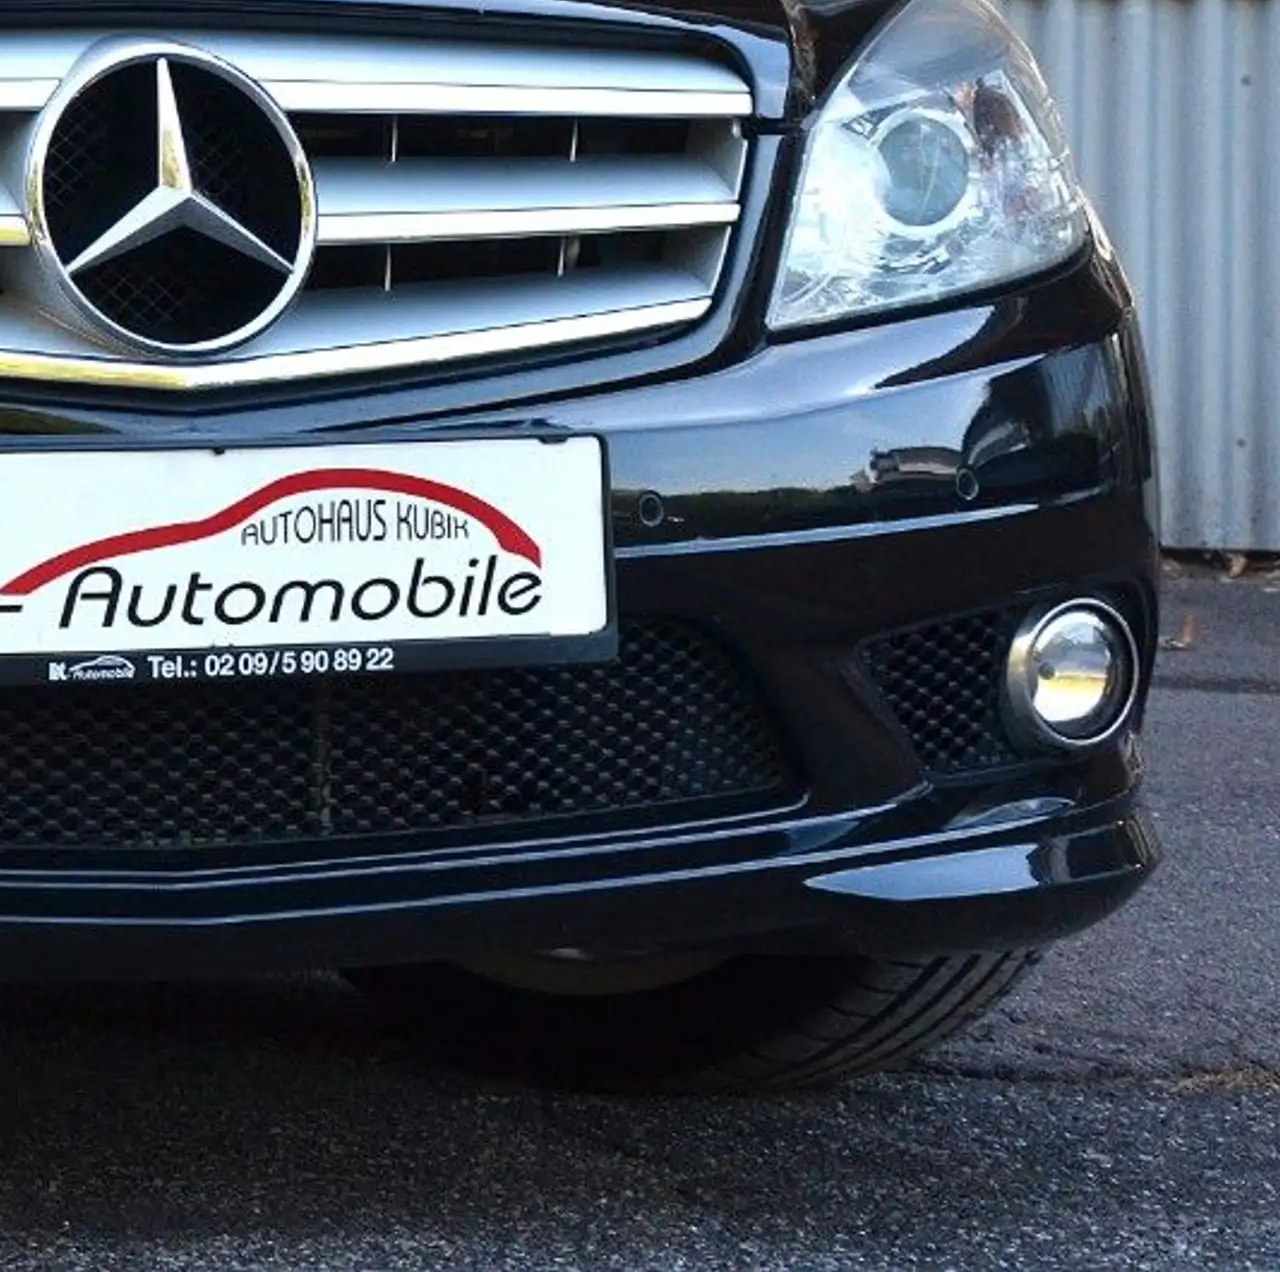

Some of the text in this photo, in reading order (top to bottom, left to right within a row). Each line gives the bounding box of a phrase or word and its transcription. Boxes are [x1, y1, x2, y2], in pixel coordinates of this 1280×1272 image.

[240, 499, 470, 546] AUTOHAUS KUBIK
[147, 654, 198, 679] Tel.:
[204, 653, 235, 677] 02
[301, 650, 329, 674] 90
[333, 648, 362, 672] 89
[365, 647, 394, 671] 22
